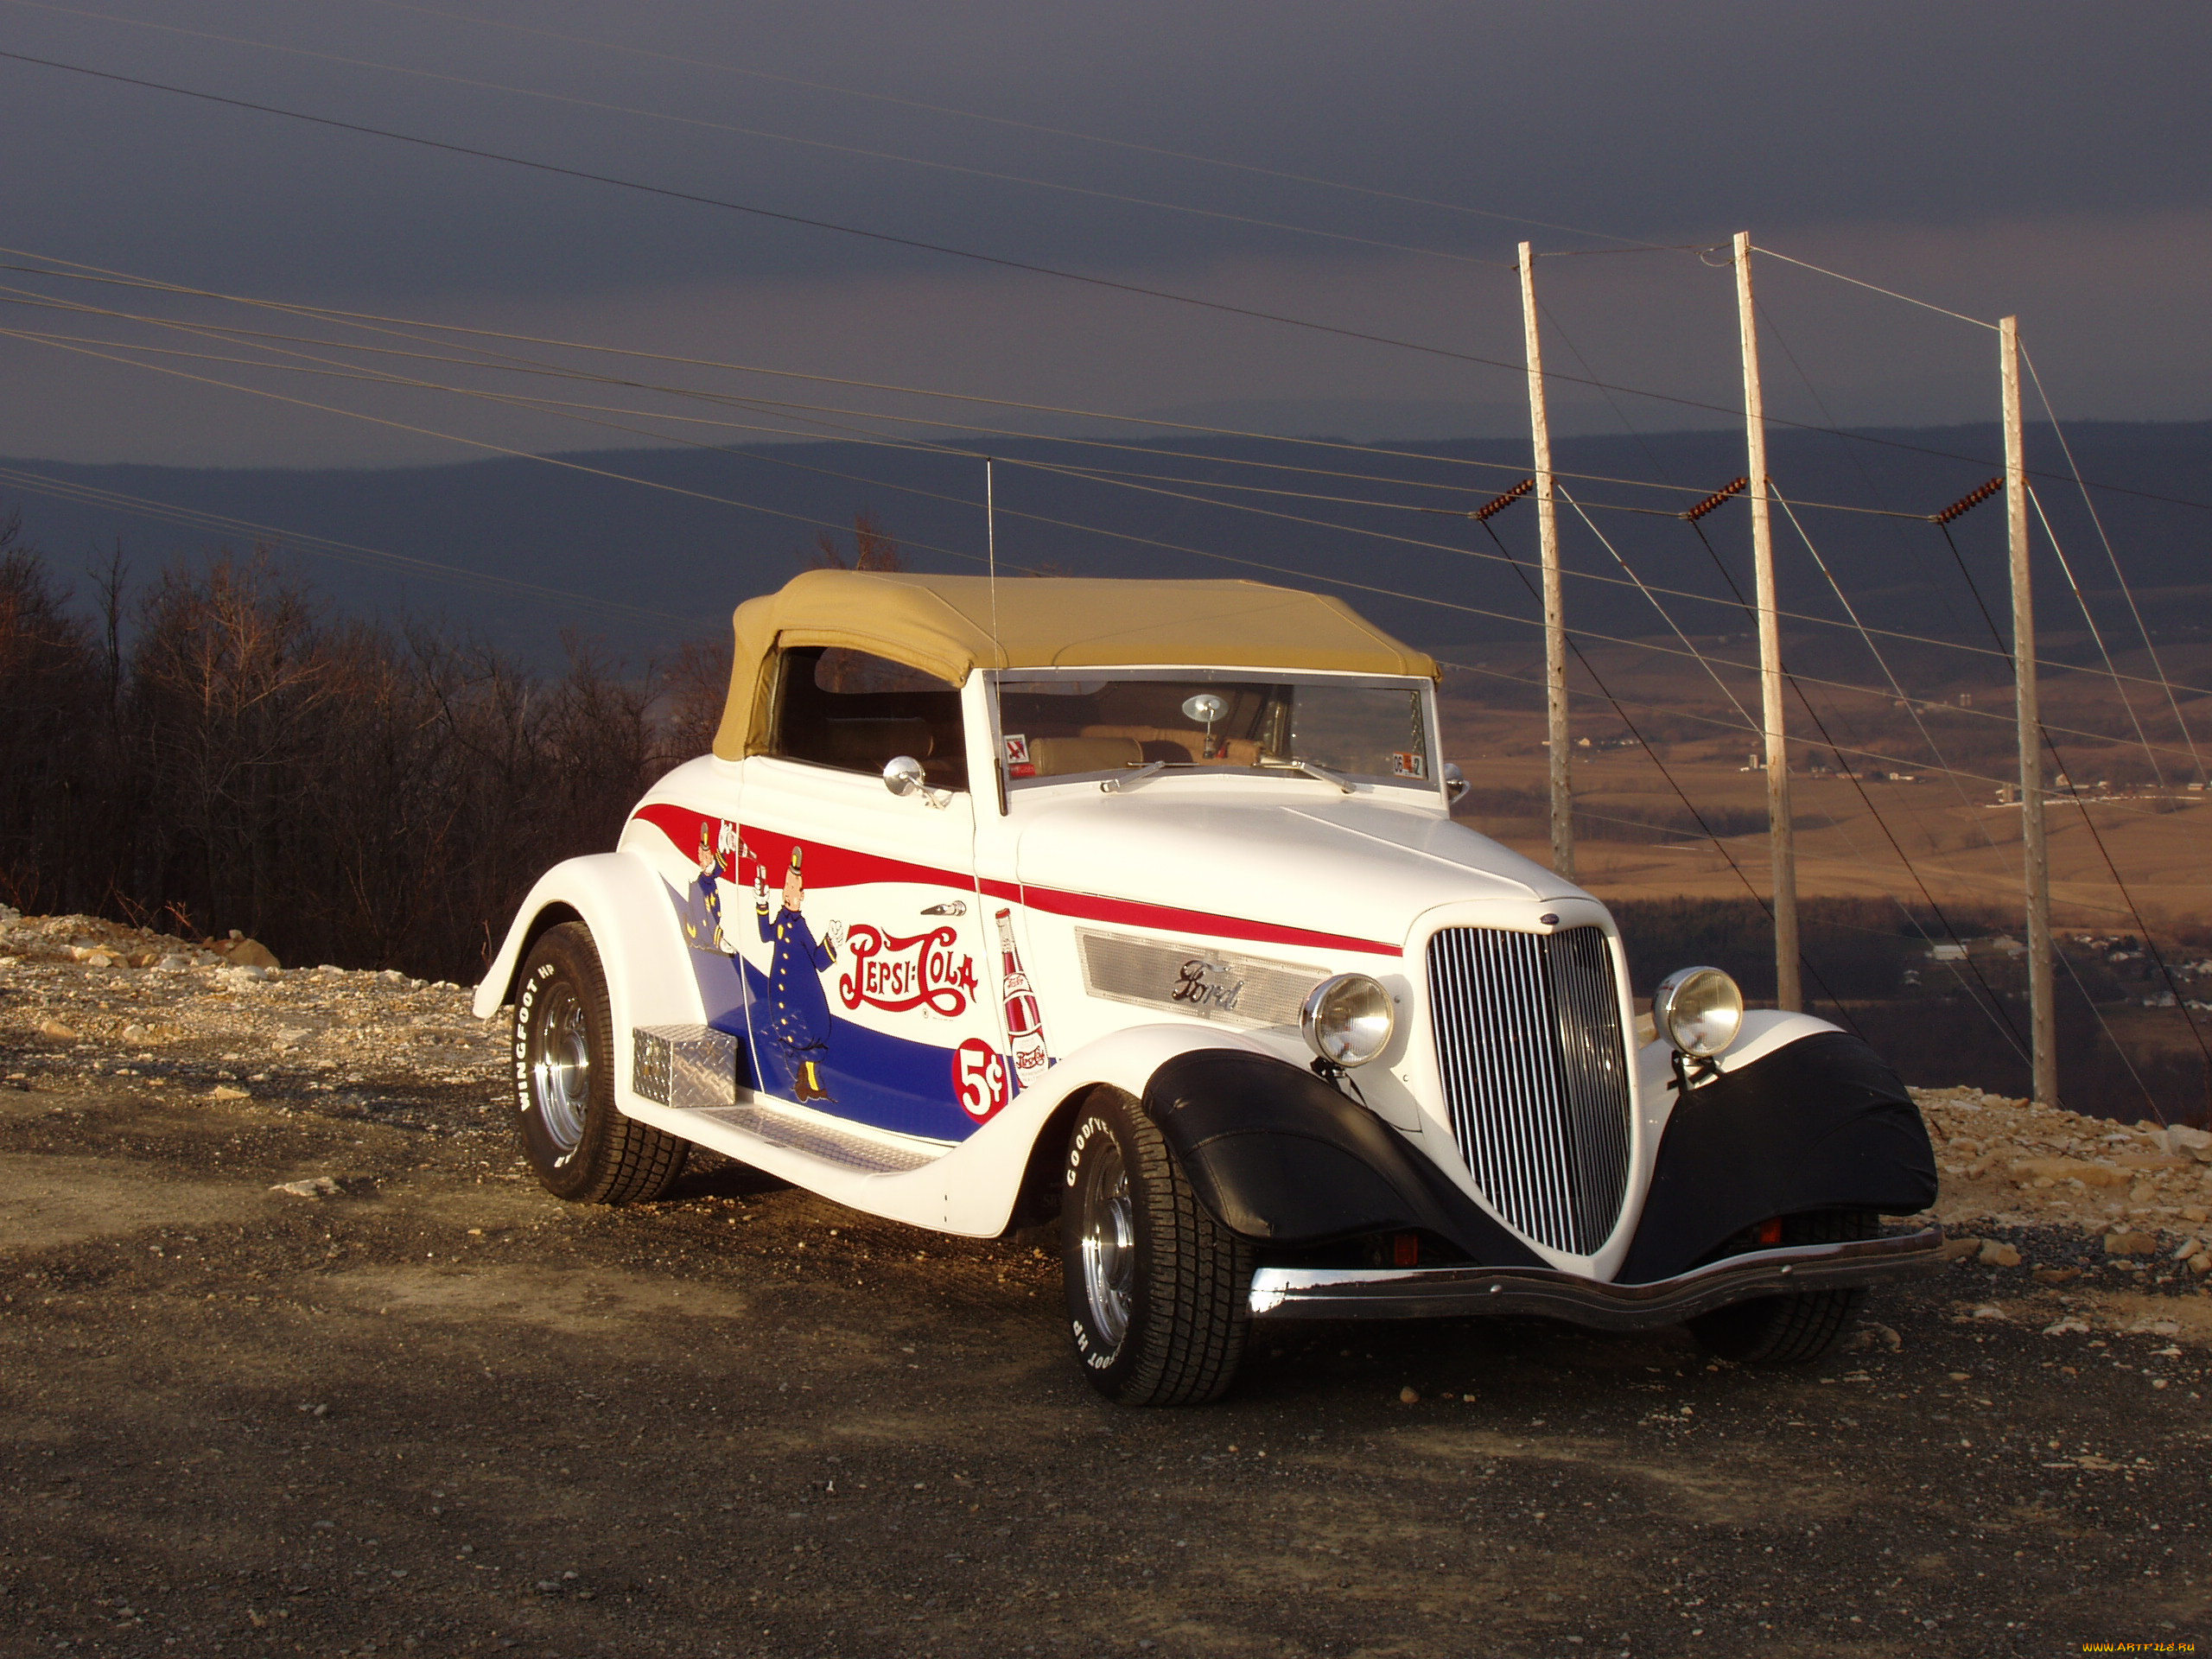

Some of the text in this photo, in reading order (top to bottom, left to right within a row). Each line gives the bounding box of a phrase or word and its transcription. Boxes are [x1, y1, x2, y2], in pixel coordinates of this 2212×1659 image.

[1172, 960, 1244, 1010] Ford
[516, 963, 555, 1112] WINGFOOT HP
[1073, 1320, 1089, 1352] HP
